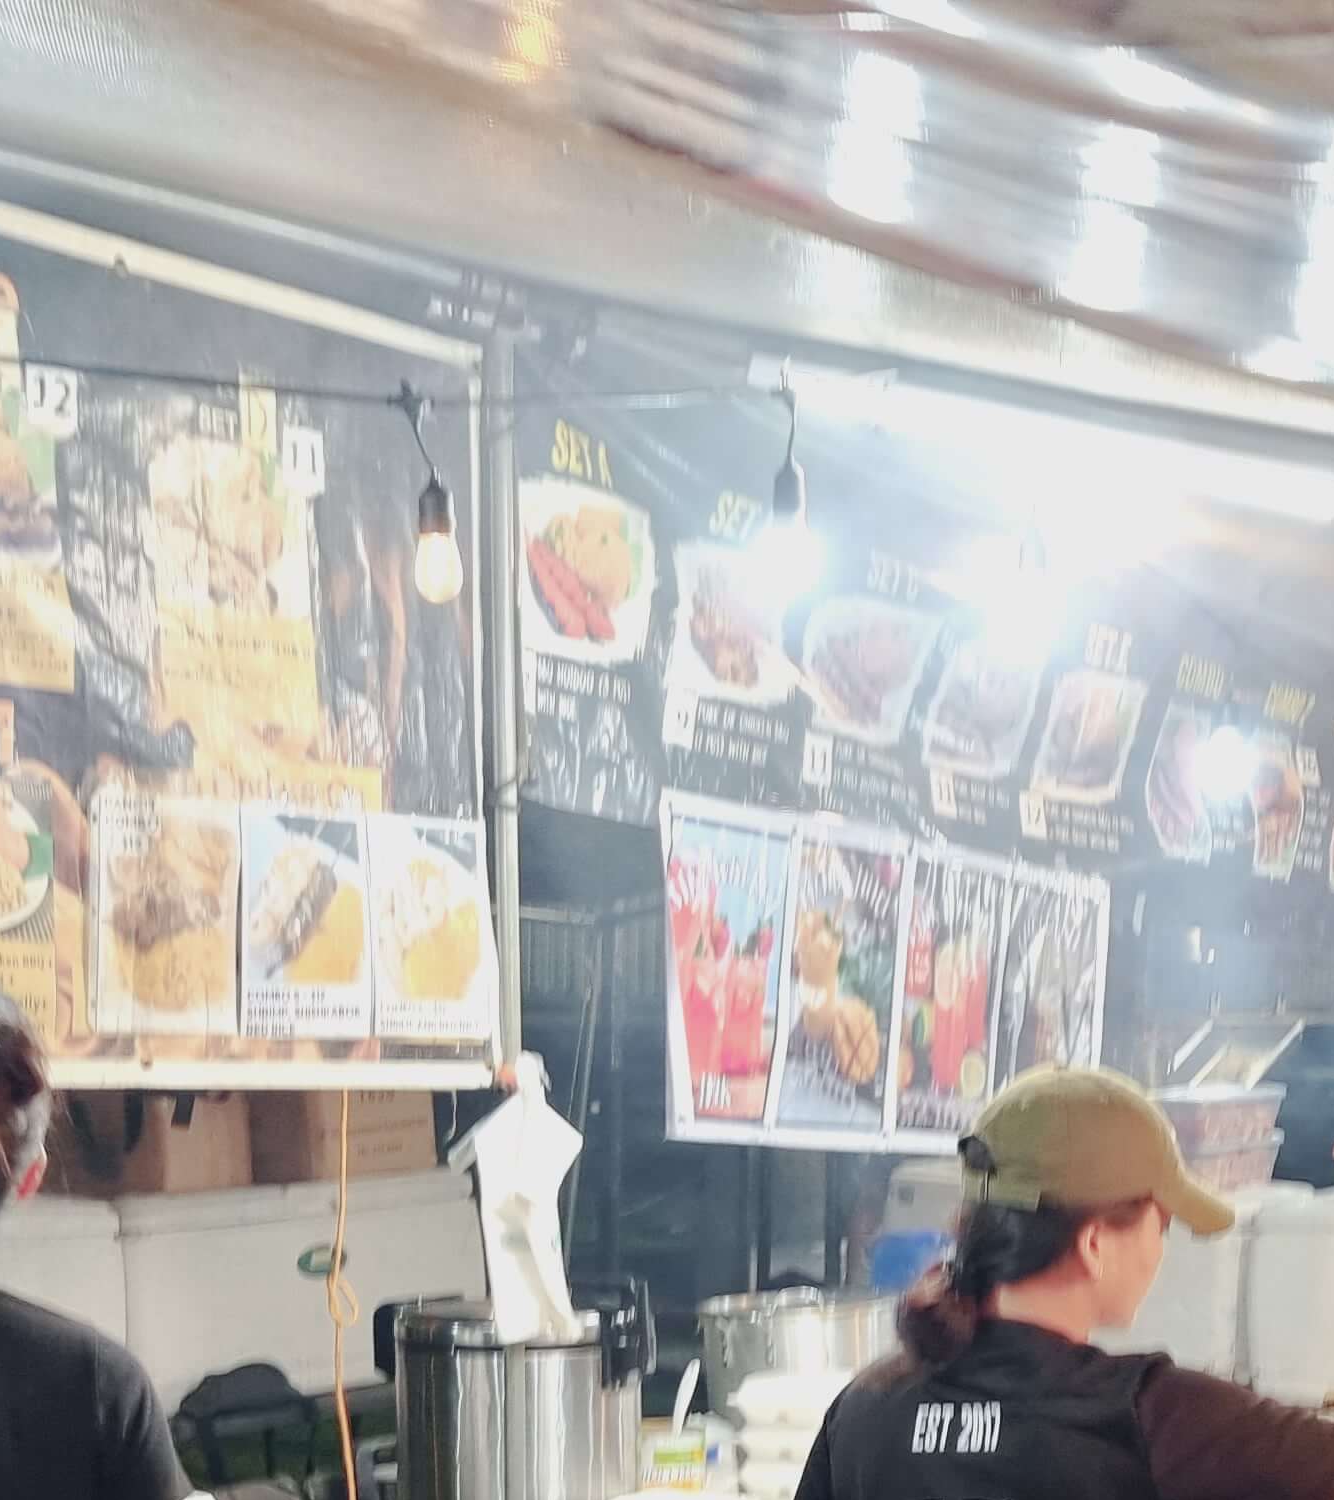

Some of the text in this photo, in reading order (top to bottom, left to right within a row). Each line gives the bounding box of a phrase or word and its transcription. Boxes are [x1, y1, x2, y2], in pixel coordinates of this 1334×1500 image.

[31, 375, 71, 418] 12
[911, 1400, 1002, 1454] EST 2017
